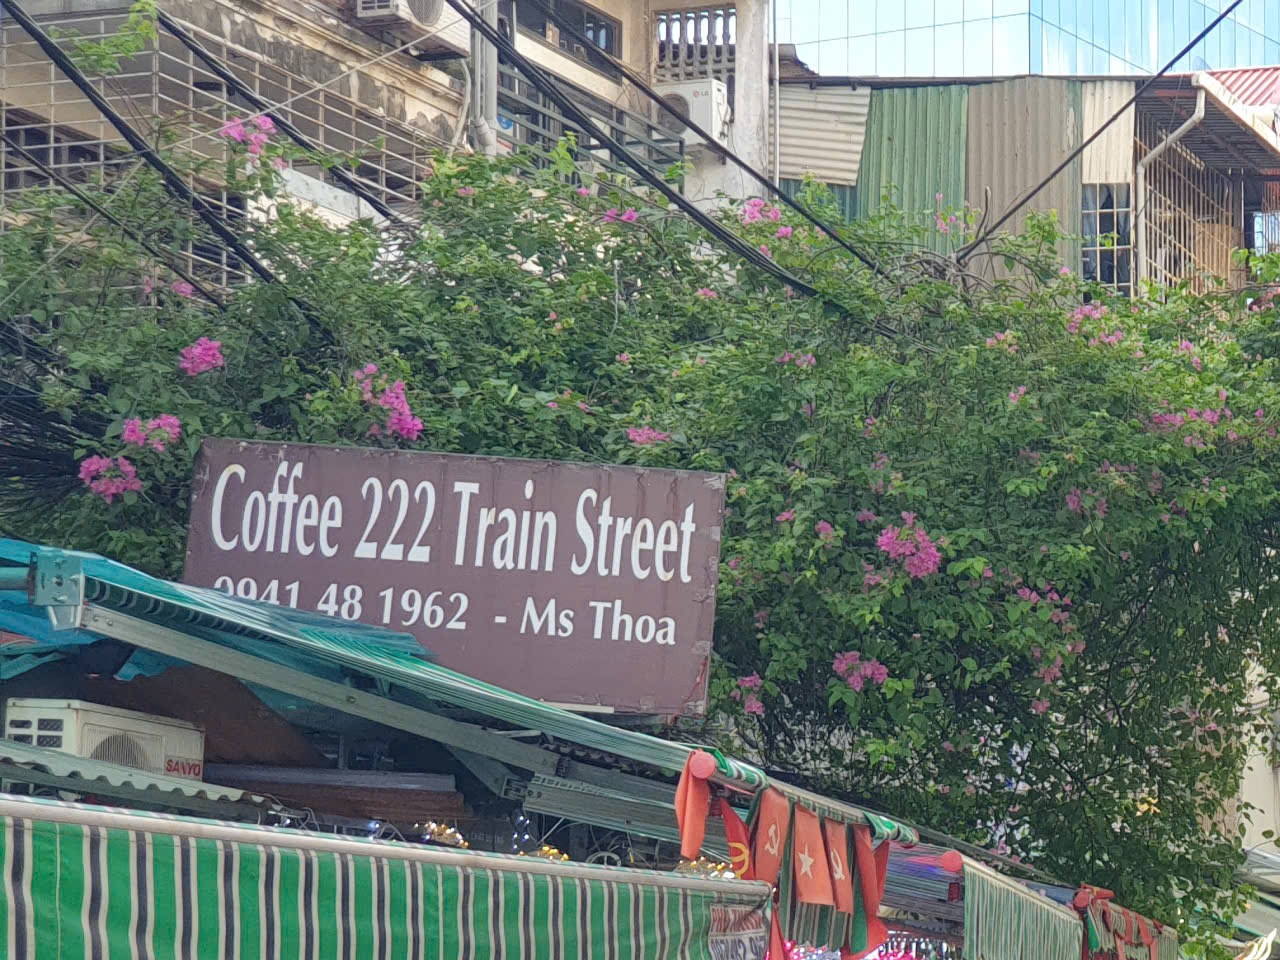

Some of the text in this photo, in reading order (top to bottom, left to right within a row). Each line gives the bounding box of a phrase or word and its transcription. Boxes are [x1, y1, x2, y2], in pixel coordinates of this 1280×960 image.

[211, 461, 696, 584] Coffee 222 Train Street
[316, 583, 364, 621] 48
[378, 586, 470, 631] 1962
[519, 597, 575, 638] Ms
[588, 600, 677, 647] Thoa
[166, 758, 201, 777] SANYO
